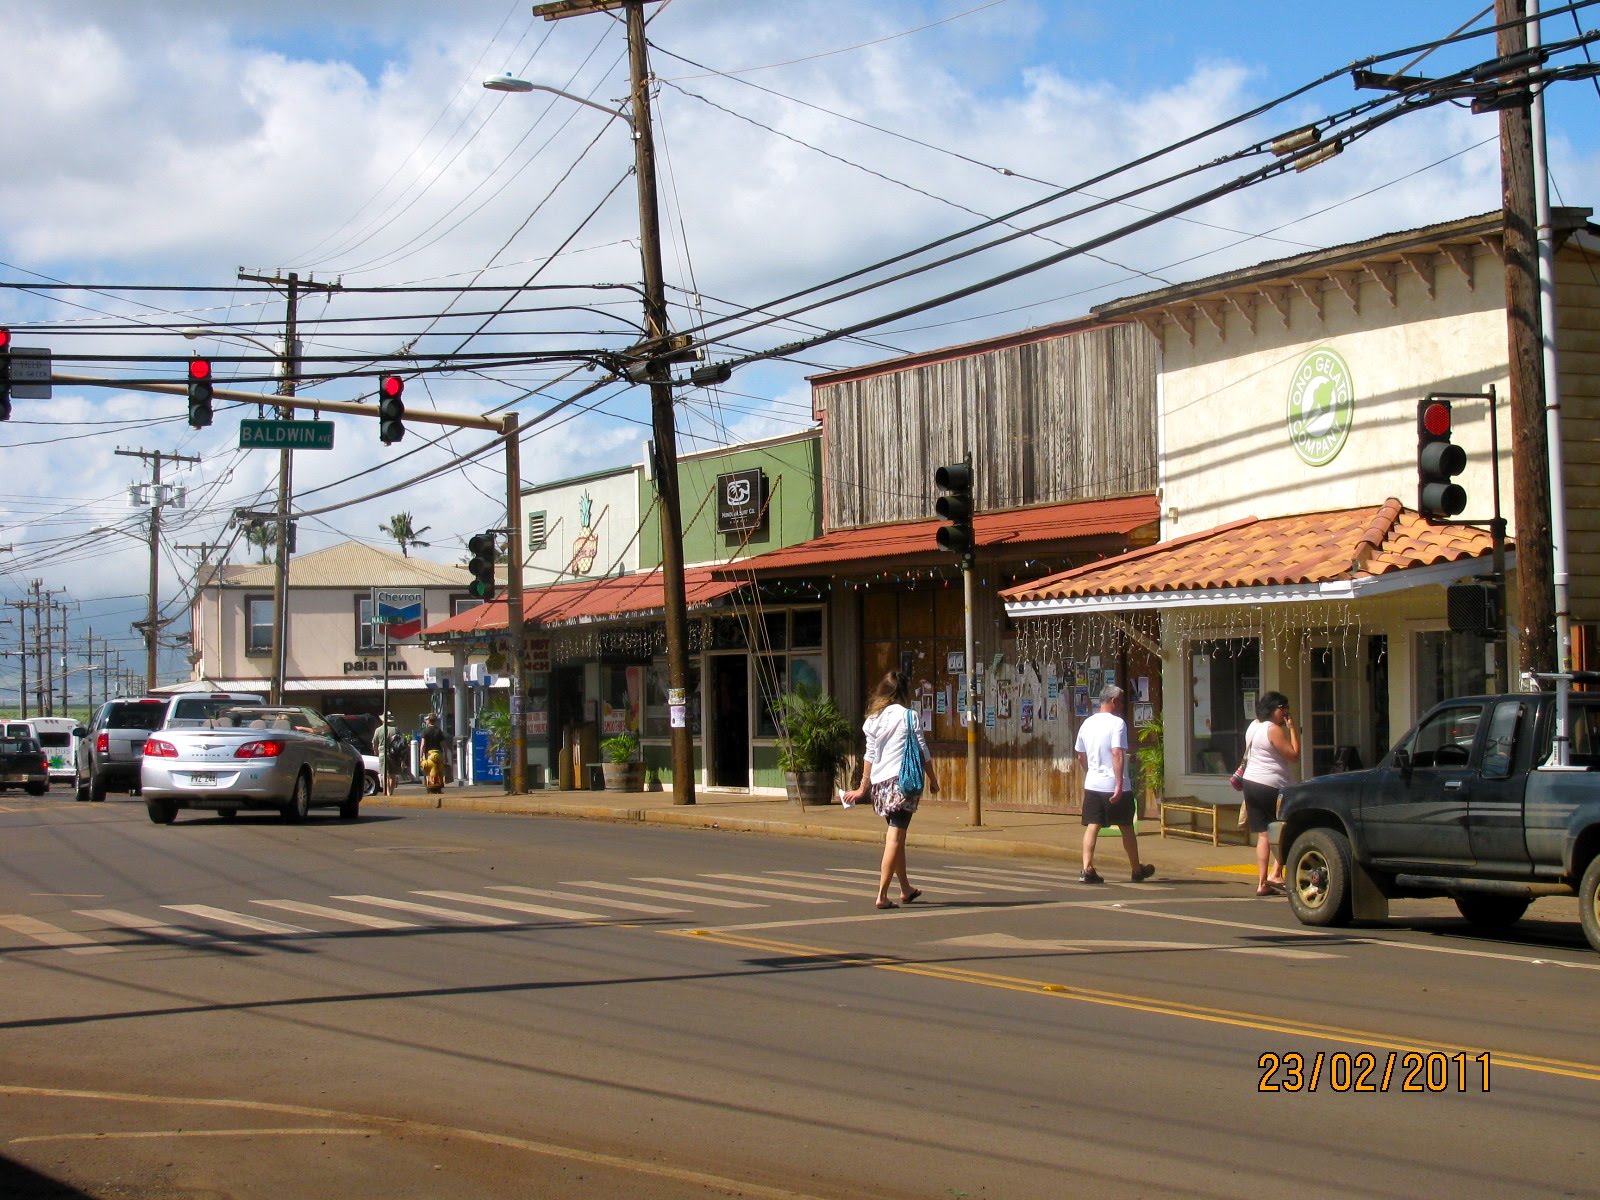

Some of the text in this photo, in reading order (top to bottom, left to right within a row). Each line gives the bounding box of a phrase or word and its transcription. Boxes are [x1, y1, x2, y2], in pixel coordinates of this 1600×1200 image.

[1292, 356, 1348, 406] ONO GELATO
[241, 426, 331, 443] BALDWIN AVE
[1293, 419, 1343, 457] COMPANY
[378, 592, 422, 602] Chevron
[343, 658, 378, 674] paia
